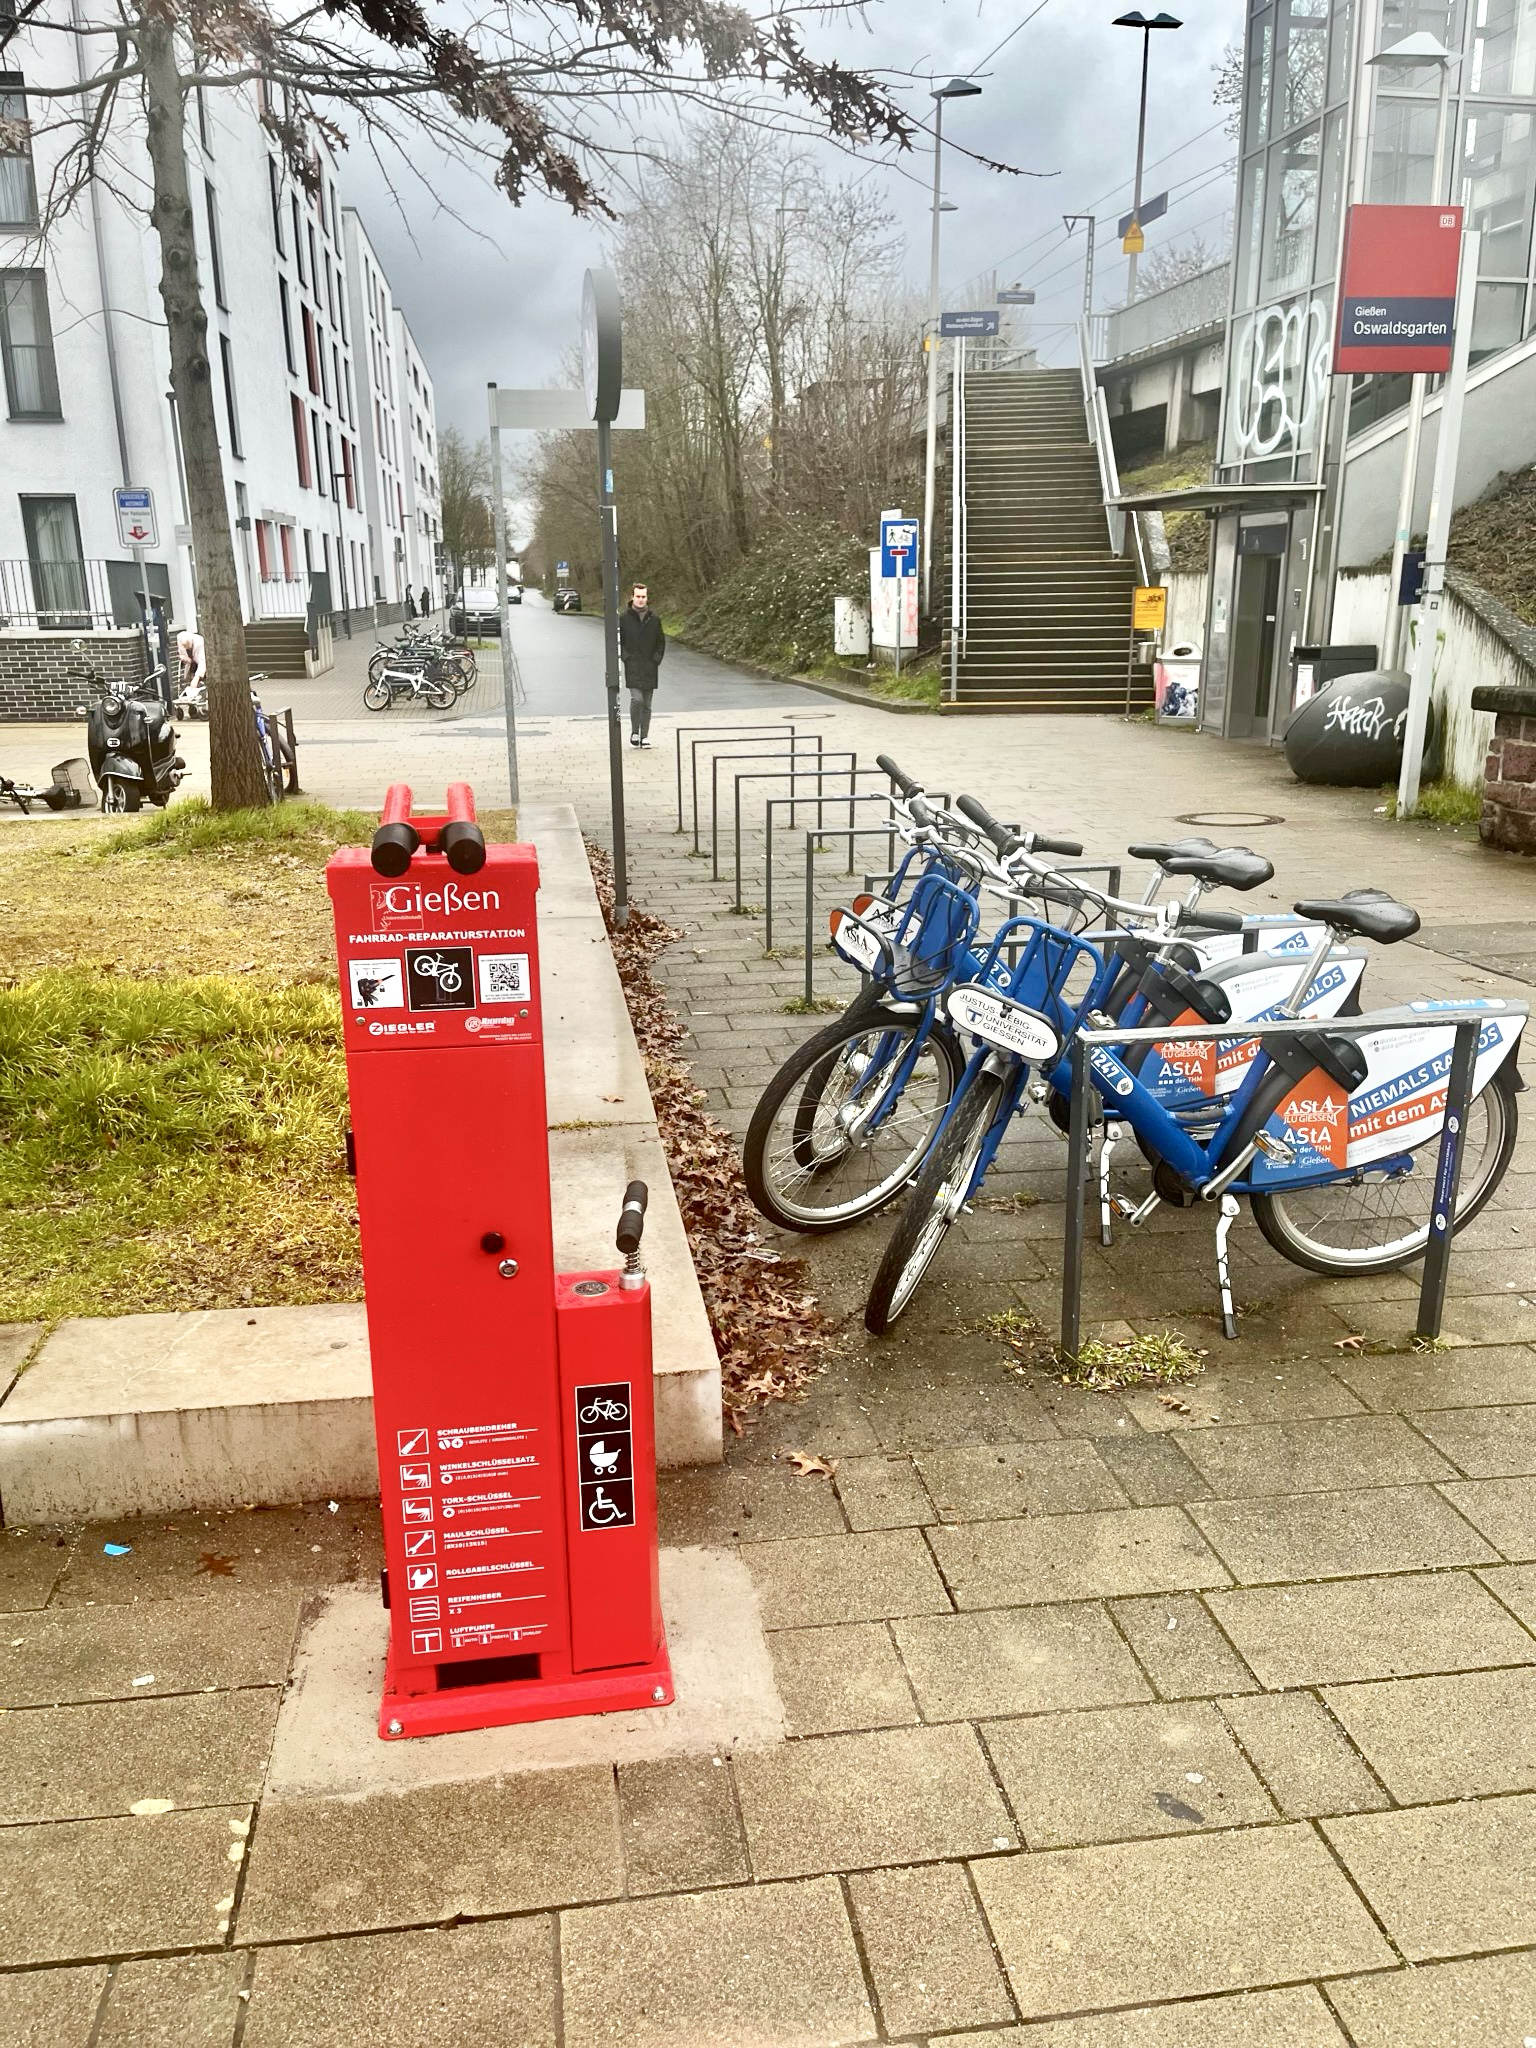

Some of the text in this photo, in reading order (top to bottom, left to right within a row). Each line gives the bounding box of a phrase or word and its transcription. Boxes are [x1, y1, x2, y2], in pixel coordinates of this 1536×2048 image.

[1441, 216, 1454, 226] DB
[1355, 306, 1387, 316] Gießen
[1353, 321, 1447, 338] Oswaldsgarten
[385, 882, 500, 916] Gießen
[349, 929, 526, 944] FAHRRAD-REPARATURSTATION
[369, 1022, 435, 1036] ZIEGLER
[982, 1022, 1025, 1046] GIESSEN
[1217, 1045, 1244, 1069] mit
[1159, 1060, 1203, 1077] AStA
[1350, 1068, 1430, 1118] NIEMALS
[1284, 1096, 1335, 1115] AStA
[1283, 1113, 1334, 1125] JLU GIESSEN
[1350, 1117, 1382, 1138] mit
[1385, 1103, 1425, 1127] dem
[1283, 1126, 1331, 1145] AStA
[1299, 1144, 1332, 1154] der THM
[437, 1423, 517, 1436] SCHRAUBENDREHER
[440, 1456, 535, 1471] WINKELSCHLÜSSELSATZ
[442, 1492, 512, 1505] TORX-SCHLÜSSEL
[443, 1527, 510, 1539] MAULSCHLÜSSEL
[445, 1561, 534, 1576] ROLLGABELSCHLÜSSEL
[447, 1592, 502, 1604] REIFENHEBER
[449, 1623, 496, 1635] LUFTPUMPE
